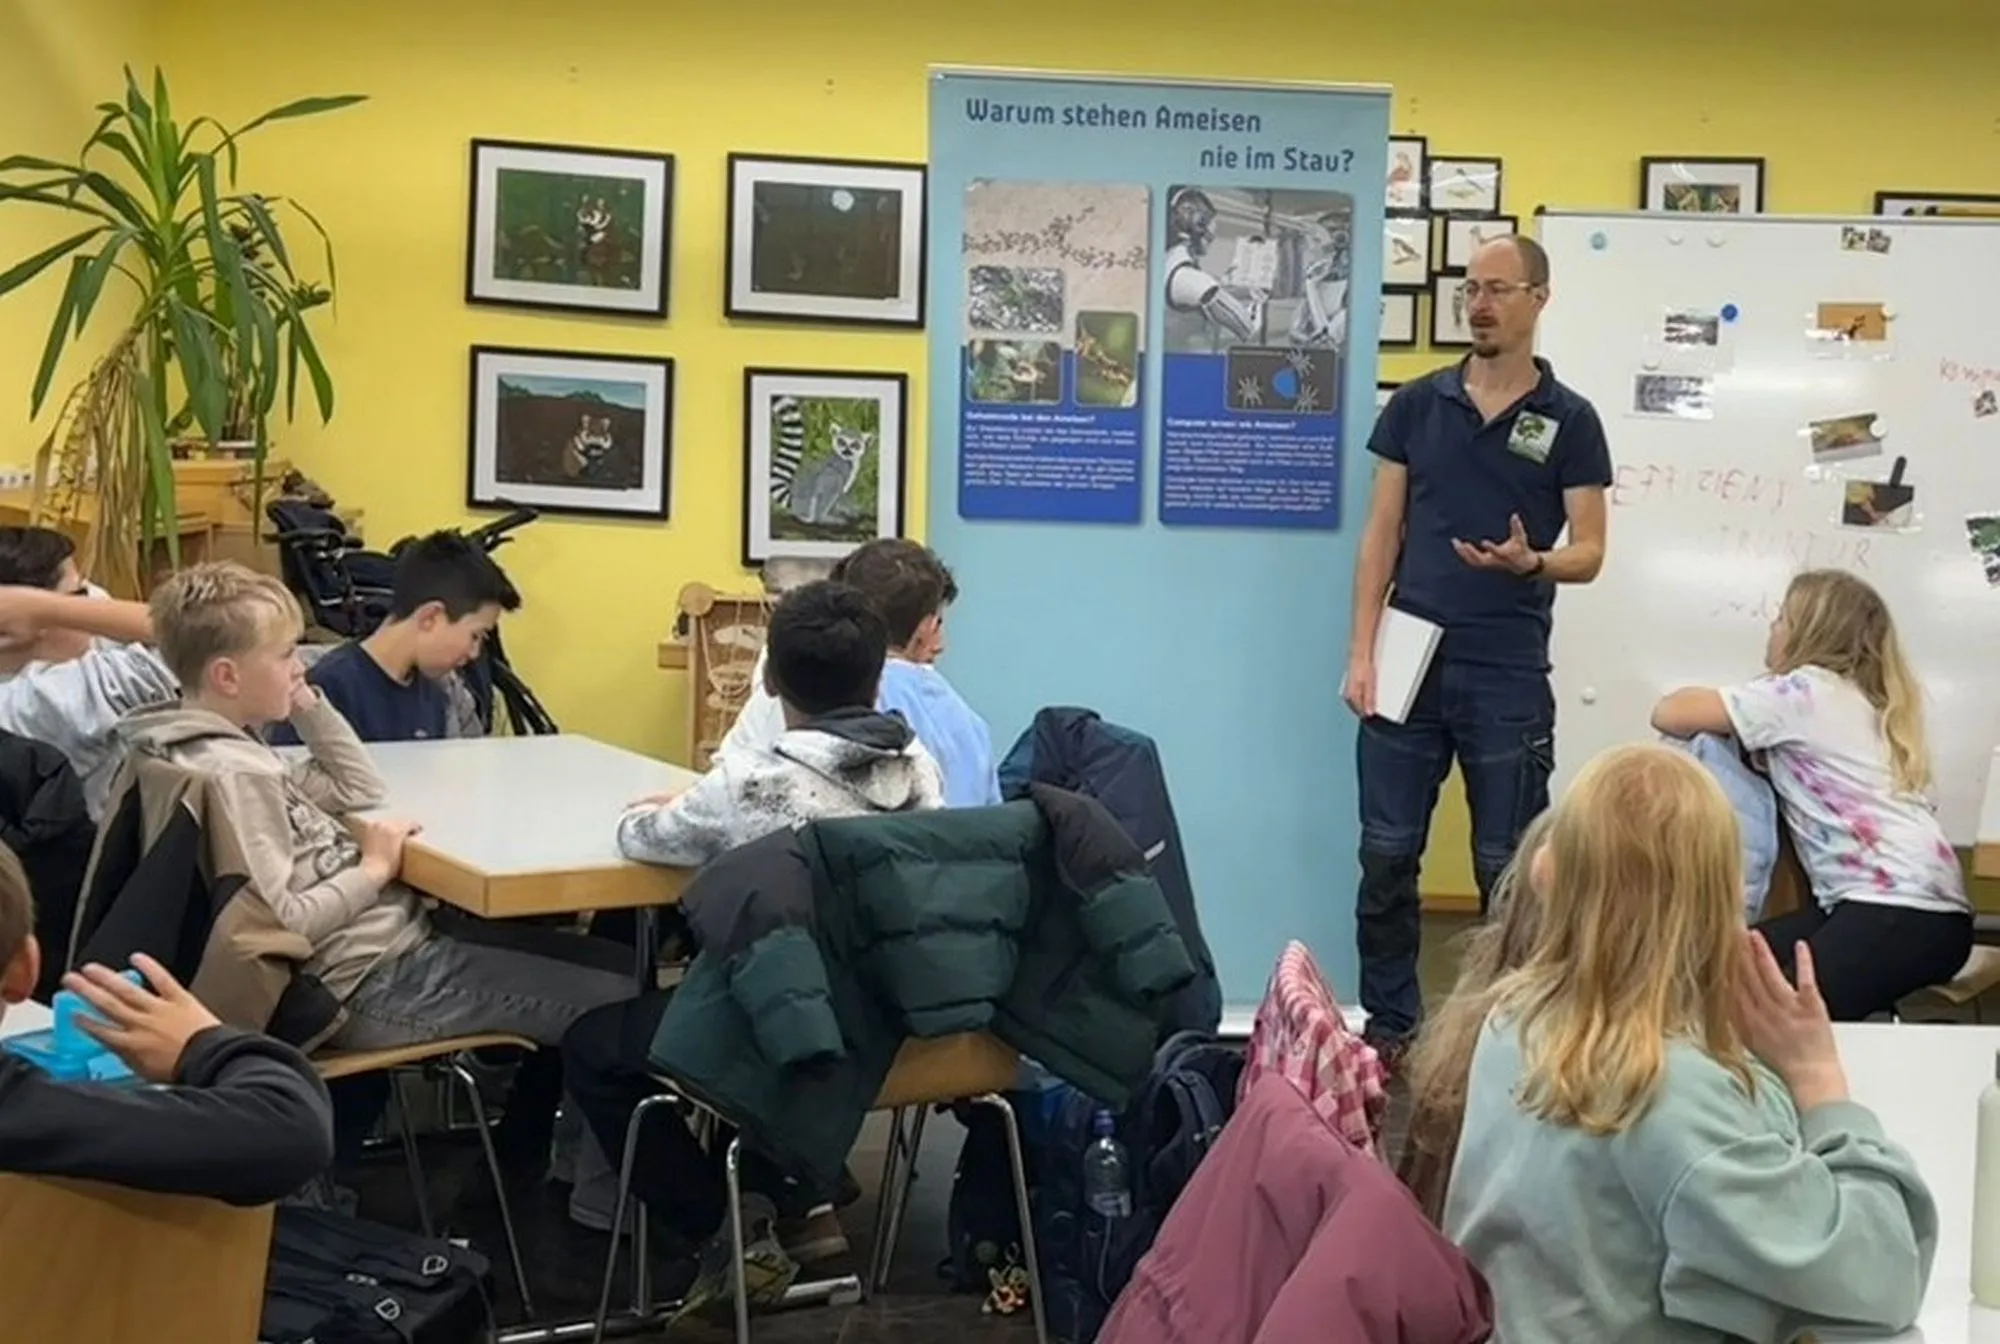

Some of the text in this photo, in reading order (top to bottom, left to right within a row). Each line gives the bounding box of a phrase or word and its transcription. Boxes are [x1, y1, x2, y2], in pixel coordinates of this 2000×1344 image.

[965, 98, 1262, 133] Warum stehen Ameisen
[1199, 145, 1355, 173] nie im Stau?
